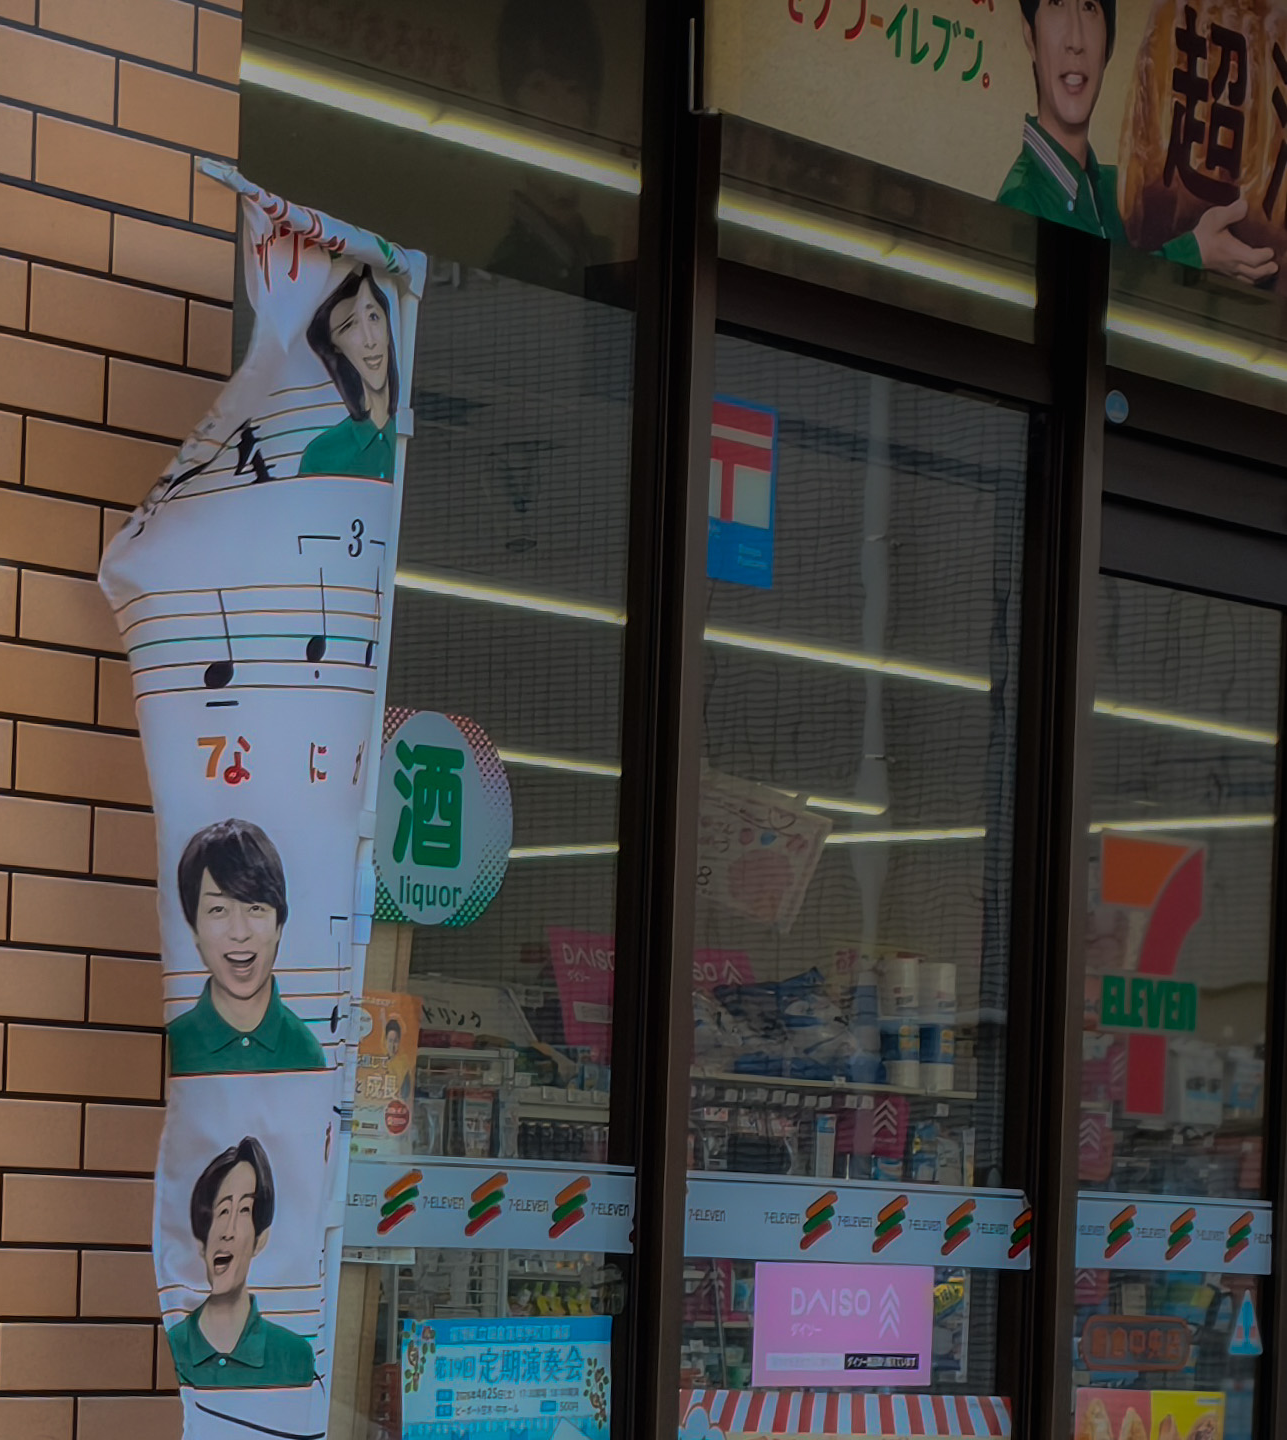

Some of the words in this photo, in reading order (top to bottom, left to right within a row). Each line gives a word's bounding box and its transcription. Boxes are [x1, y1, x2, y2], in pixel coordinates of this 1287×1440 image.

[392, 739, 466, 869] 酒
[399, 877, 462, 912] liquor
[790, 1287, 872, 1317] DAISO
